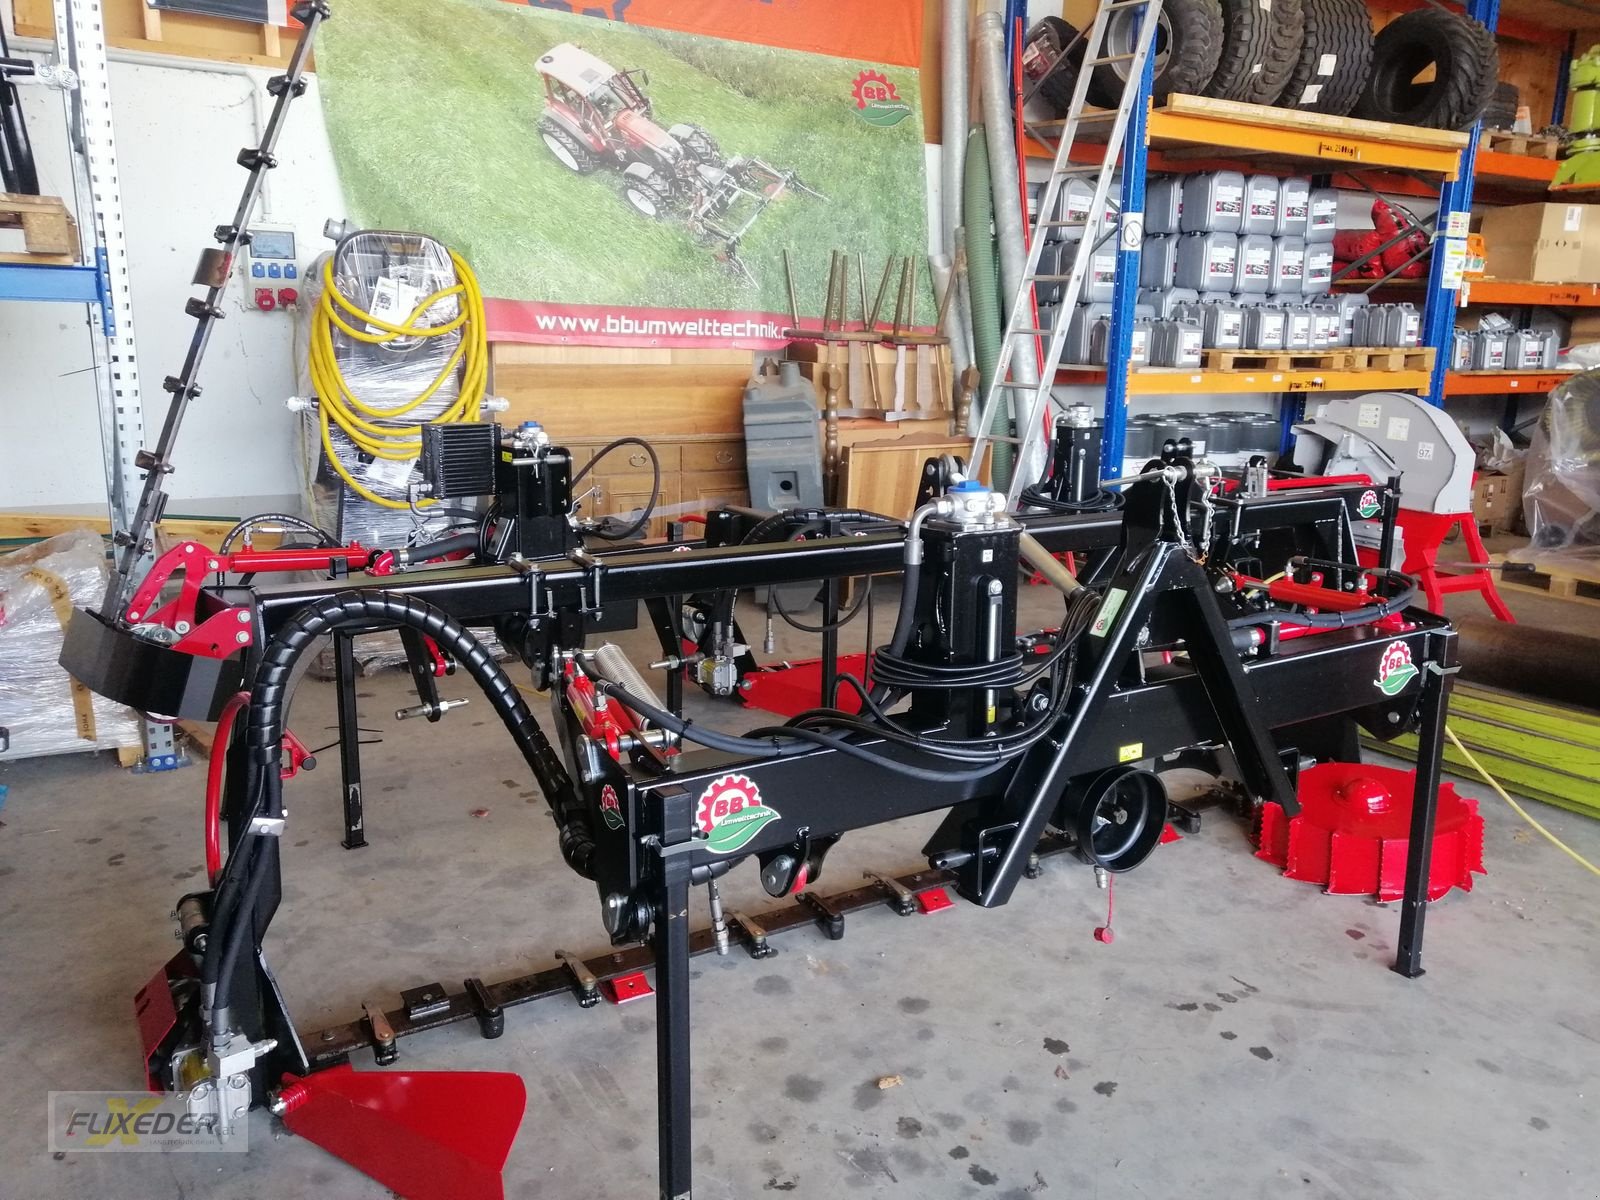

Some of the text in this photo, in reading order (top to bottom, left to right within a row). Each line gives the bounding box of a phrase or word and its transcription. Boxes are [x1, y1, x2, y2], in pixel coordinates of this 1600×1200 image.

[863, 86, 887, 102] BB
[1389, 656, 1402, 669] BB
[714, 796, 744, 818] BB
